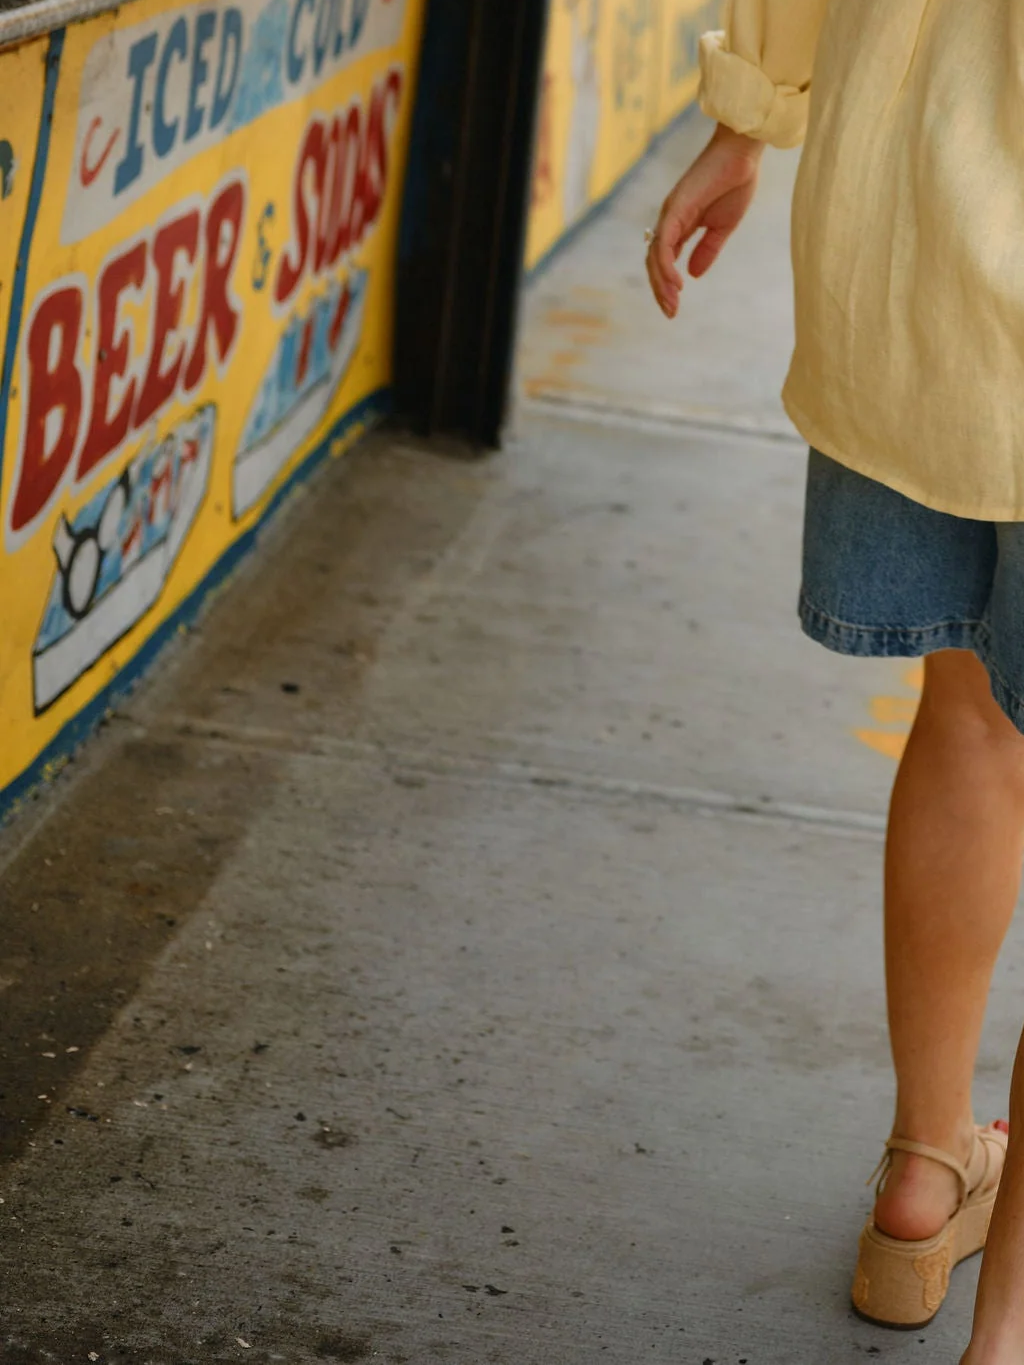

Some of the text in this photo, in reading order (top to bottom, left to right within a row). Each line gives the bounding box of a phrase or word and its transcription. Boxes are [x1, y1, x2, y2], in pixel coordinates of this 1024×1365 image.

[114, 0, 244, 196] ICED
[11, 178, 245, 532] BEER
[274, 69, 402, 303] SODAS
